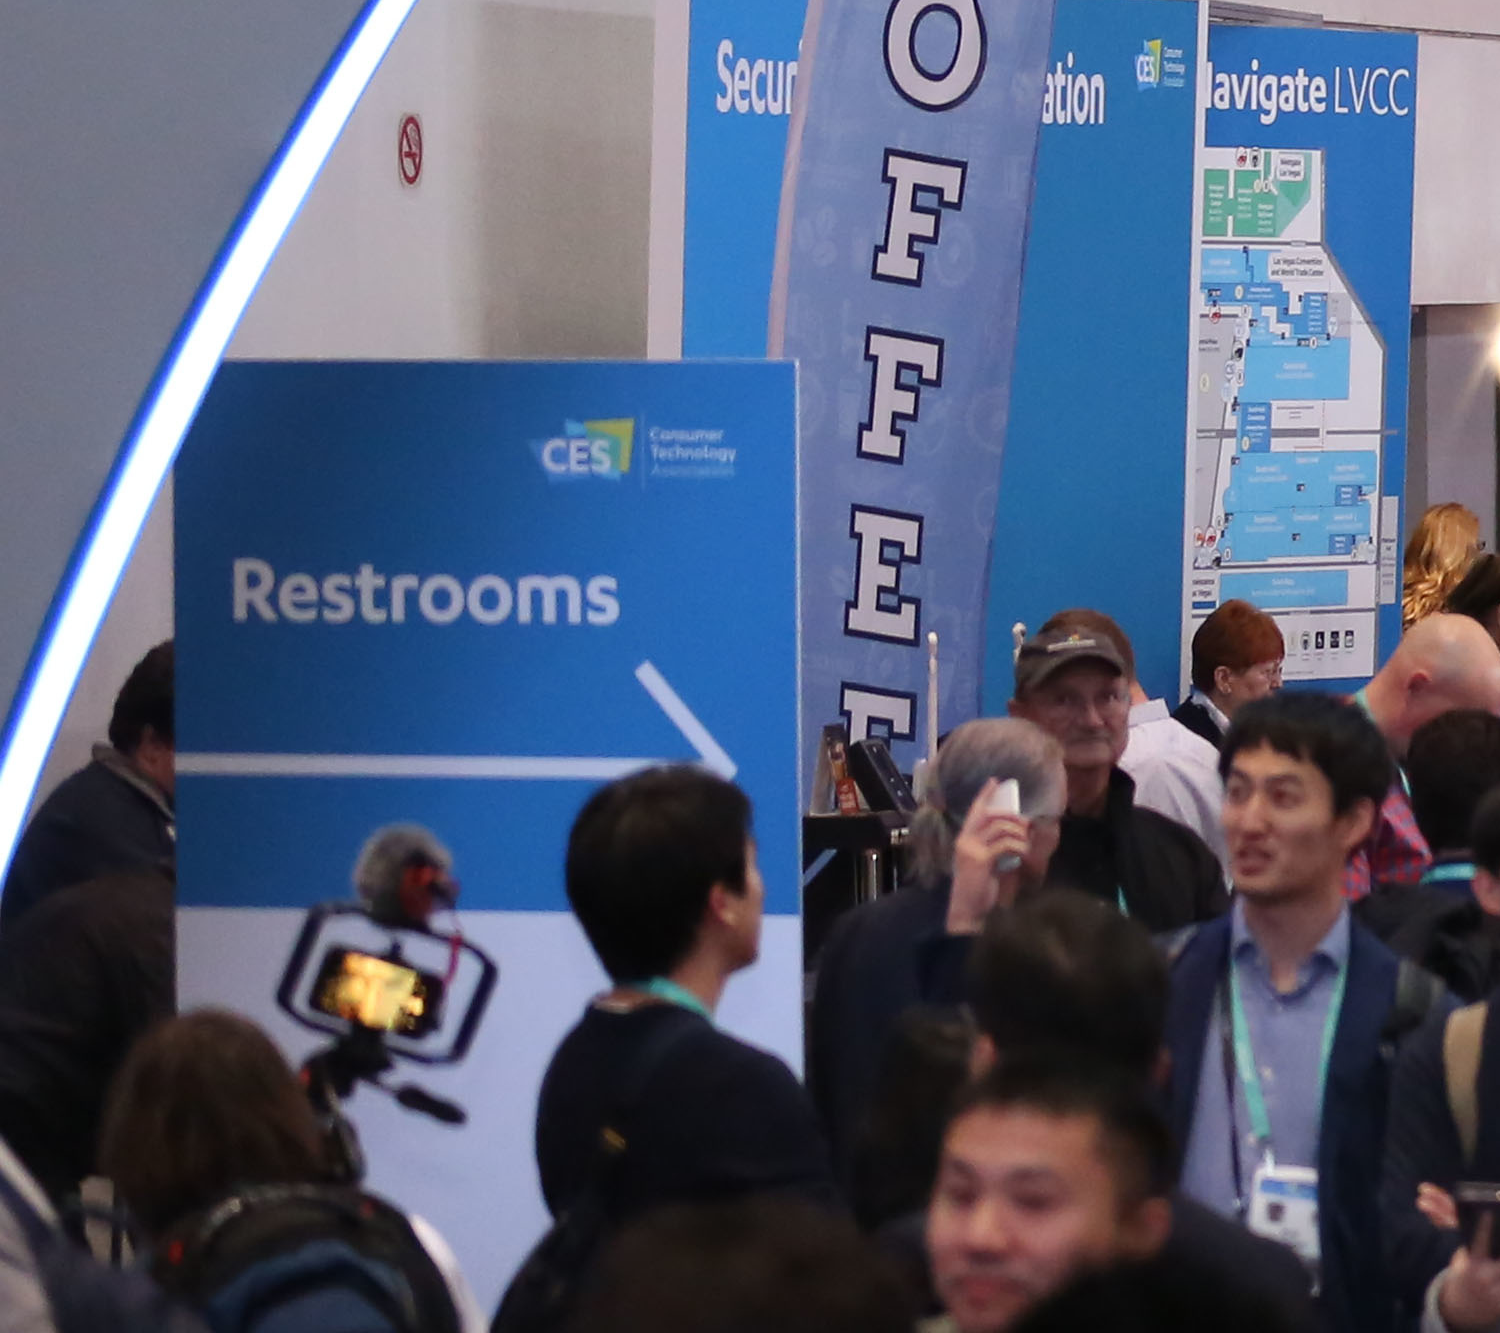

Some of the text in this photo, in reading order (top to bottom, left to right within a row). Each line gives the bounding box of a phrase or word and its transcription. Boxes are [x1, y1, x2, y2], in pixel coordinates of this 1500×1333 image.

[716, 39, 800, 117] Secur
[1041, 52, 1106, 125] ation
[1208, 58, 1411, 125] avigate LVCC
[542, 438, 612, 475] CES
[232, 557, 621, 627] Restrooms
